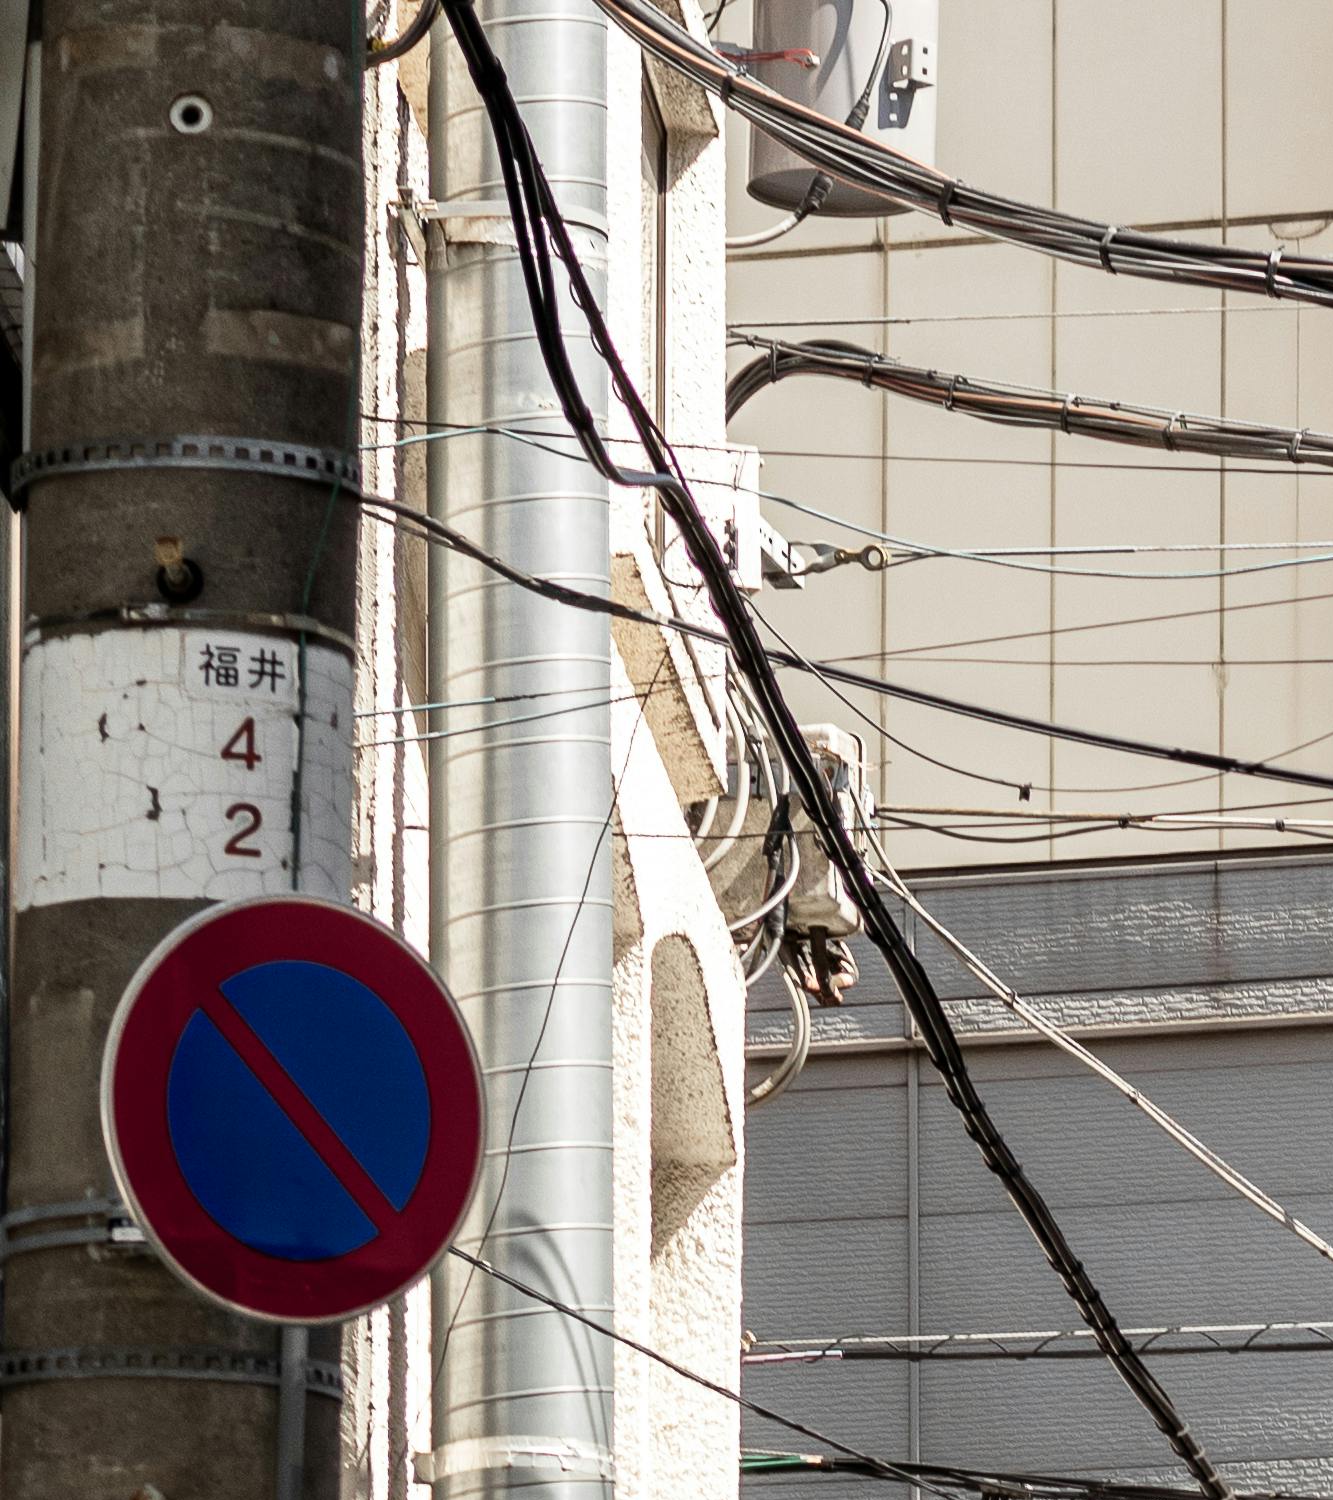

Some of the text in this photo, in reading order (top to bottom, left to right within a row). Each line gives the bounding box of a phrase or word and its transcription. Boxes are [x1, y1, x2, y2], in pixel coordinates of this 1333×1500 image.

[199, 643, 287, 692] 福井
[221, 716, 263, 772] 4
[223, 803, 263, 858] 2
